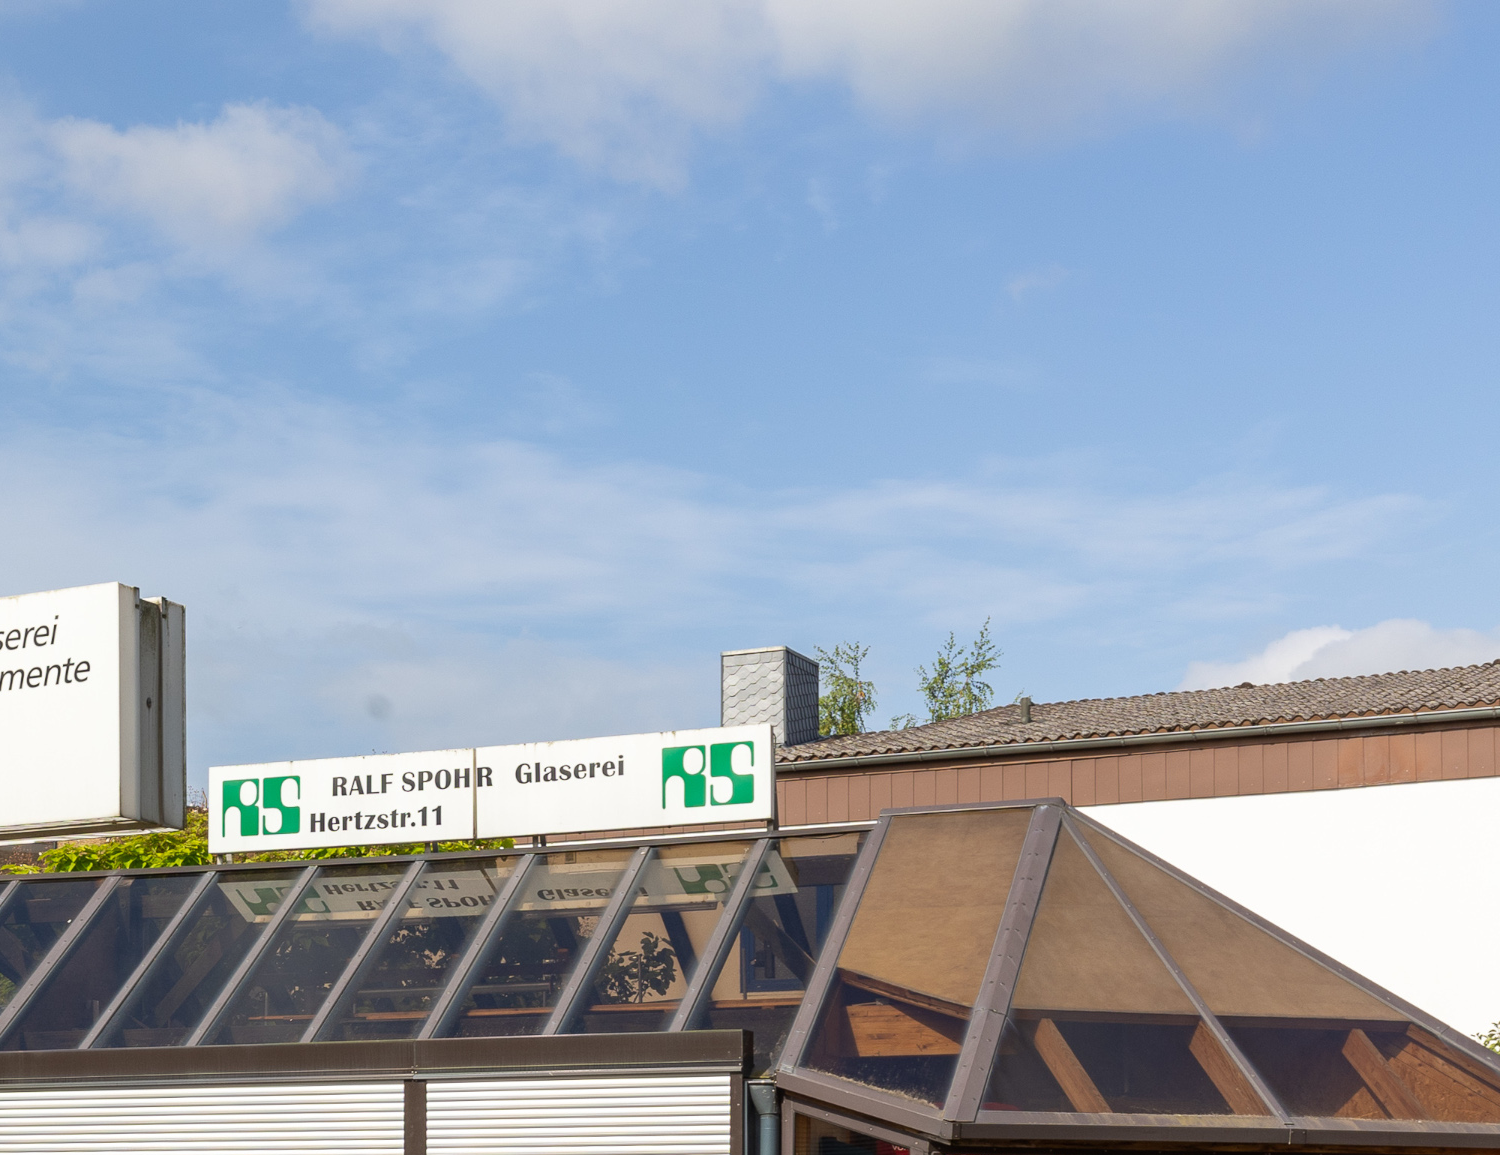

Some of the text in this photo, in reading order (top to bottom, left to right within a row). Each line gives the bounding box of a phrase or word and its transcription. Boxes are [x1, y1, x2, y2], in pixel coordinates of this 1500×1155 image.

[331, 755, 626, 797] RALF SPOHR Glaserei
[310, 805, 444, 834] Hertzstr.11
